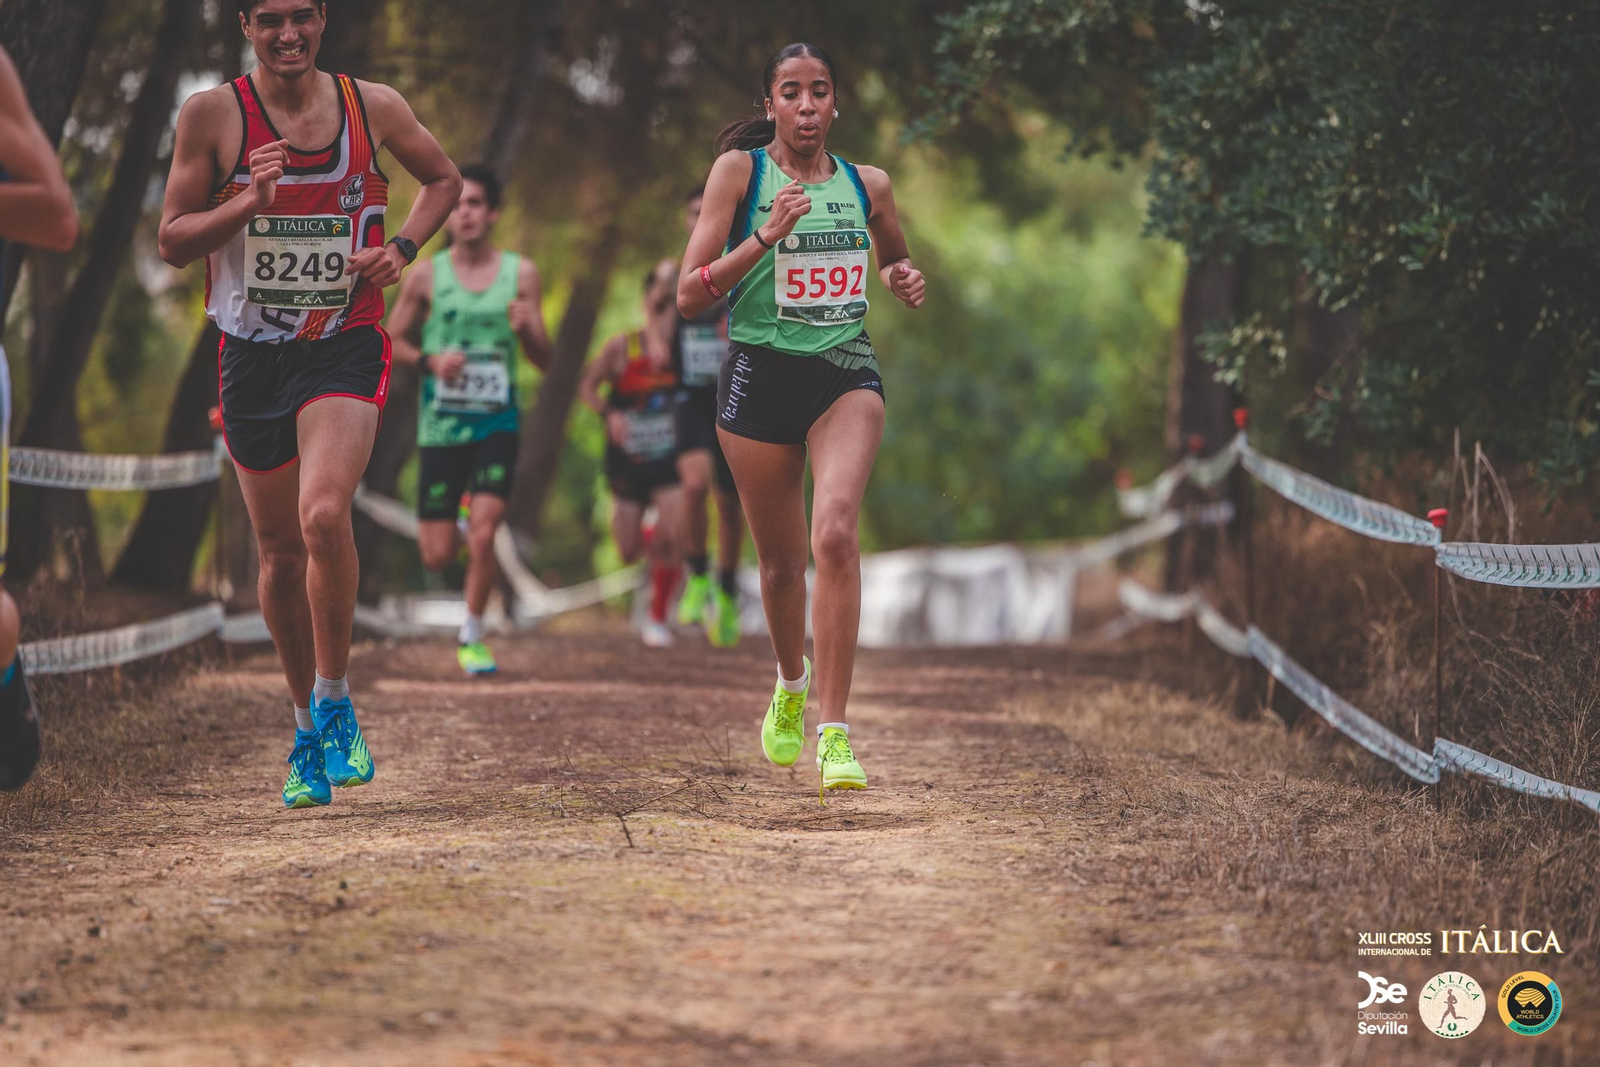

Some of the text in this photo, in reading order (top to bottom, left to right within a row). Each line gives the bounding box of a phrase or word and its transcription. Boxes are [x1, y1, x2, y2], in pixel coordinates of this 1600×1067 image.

[343, 193, 362, 206] CAPS
[277, 219, 326, 231] ITÁLICA
[806, 233, 851, 247] ITÁLICA
[254, 251, 344, 282] 8249
[786, 265, 863, 300] 5592
